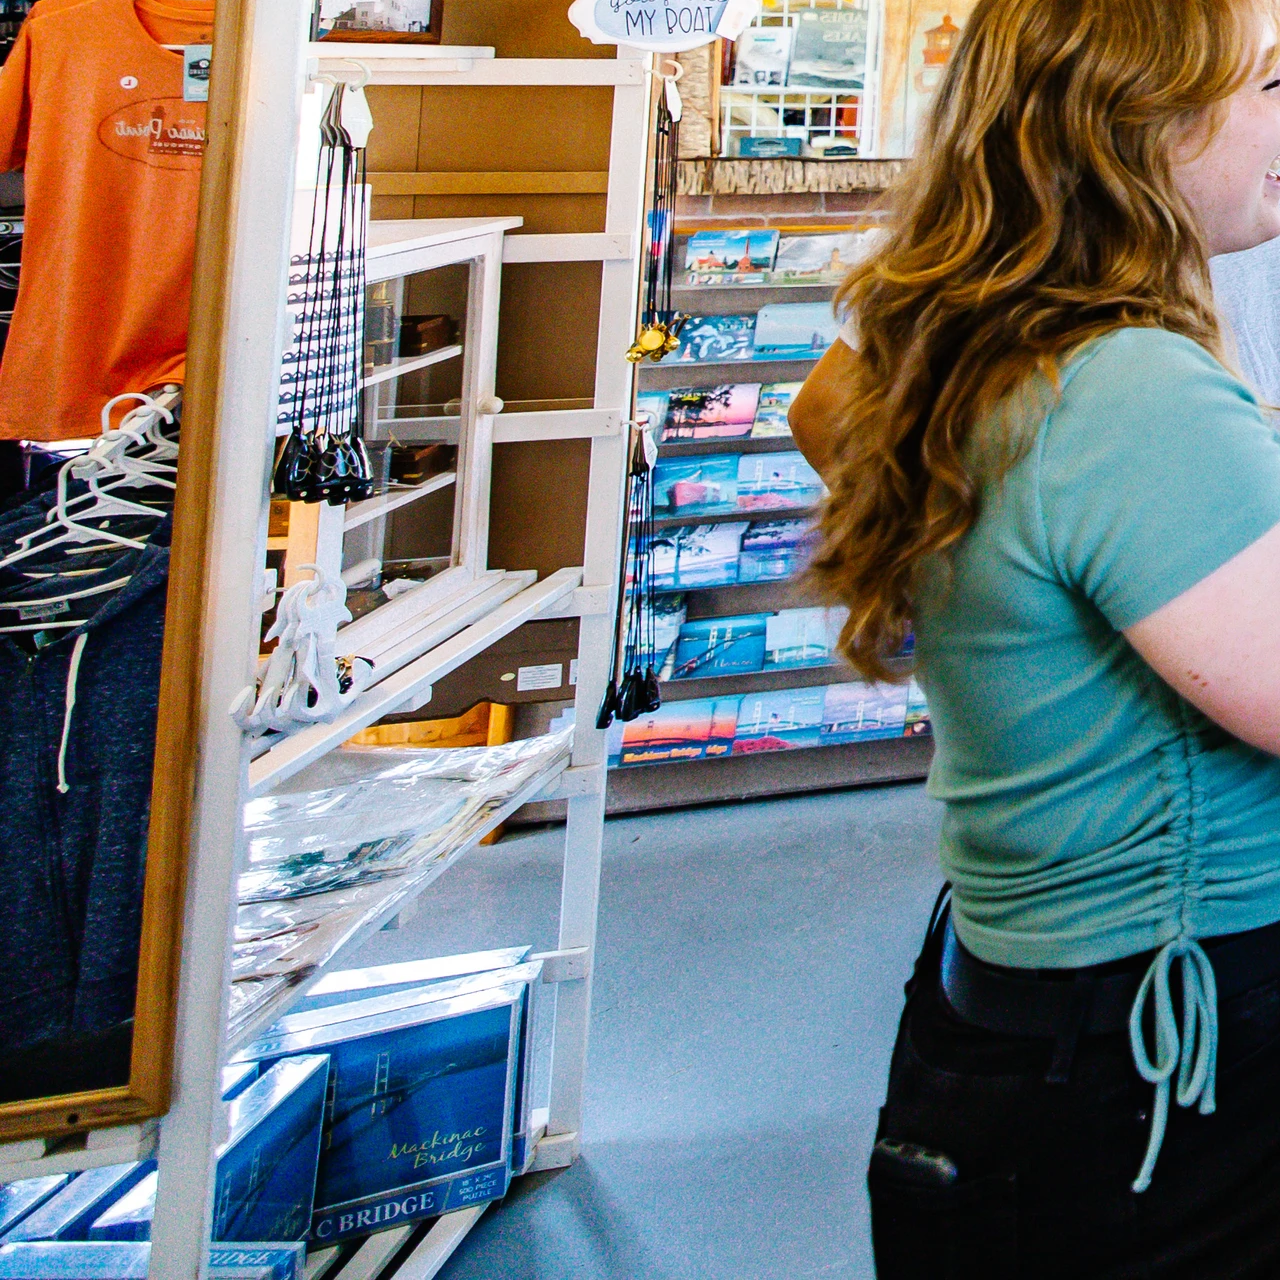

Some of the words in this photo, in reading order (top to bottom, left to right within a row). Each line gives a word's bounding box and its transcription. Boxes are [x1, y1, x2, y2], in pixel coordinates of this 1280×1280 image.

[625, 9, 657, 36] MY
[665, 6, 713, 35] BOAT
[386, 1126, 488, 1160] Mackinac
[413, 1140, 487, 1170] Bridge
[461, 1188, 492, 1202] PUZZLE
[475, 1180, 497, 1192] PIECE
[338, 1191, 435, 1234] BRIDGE
